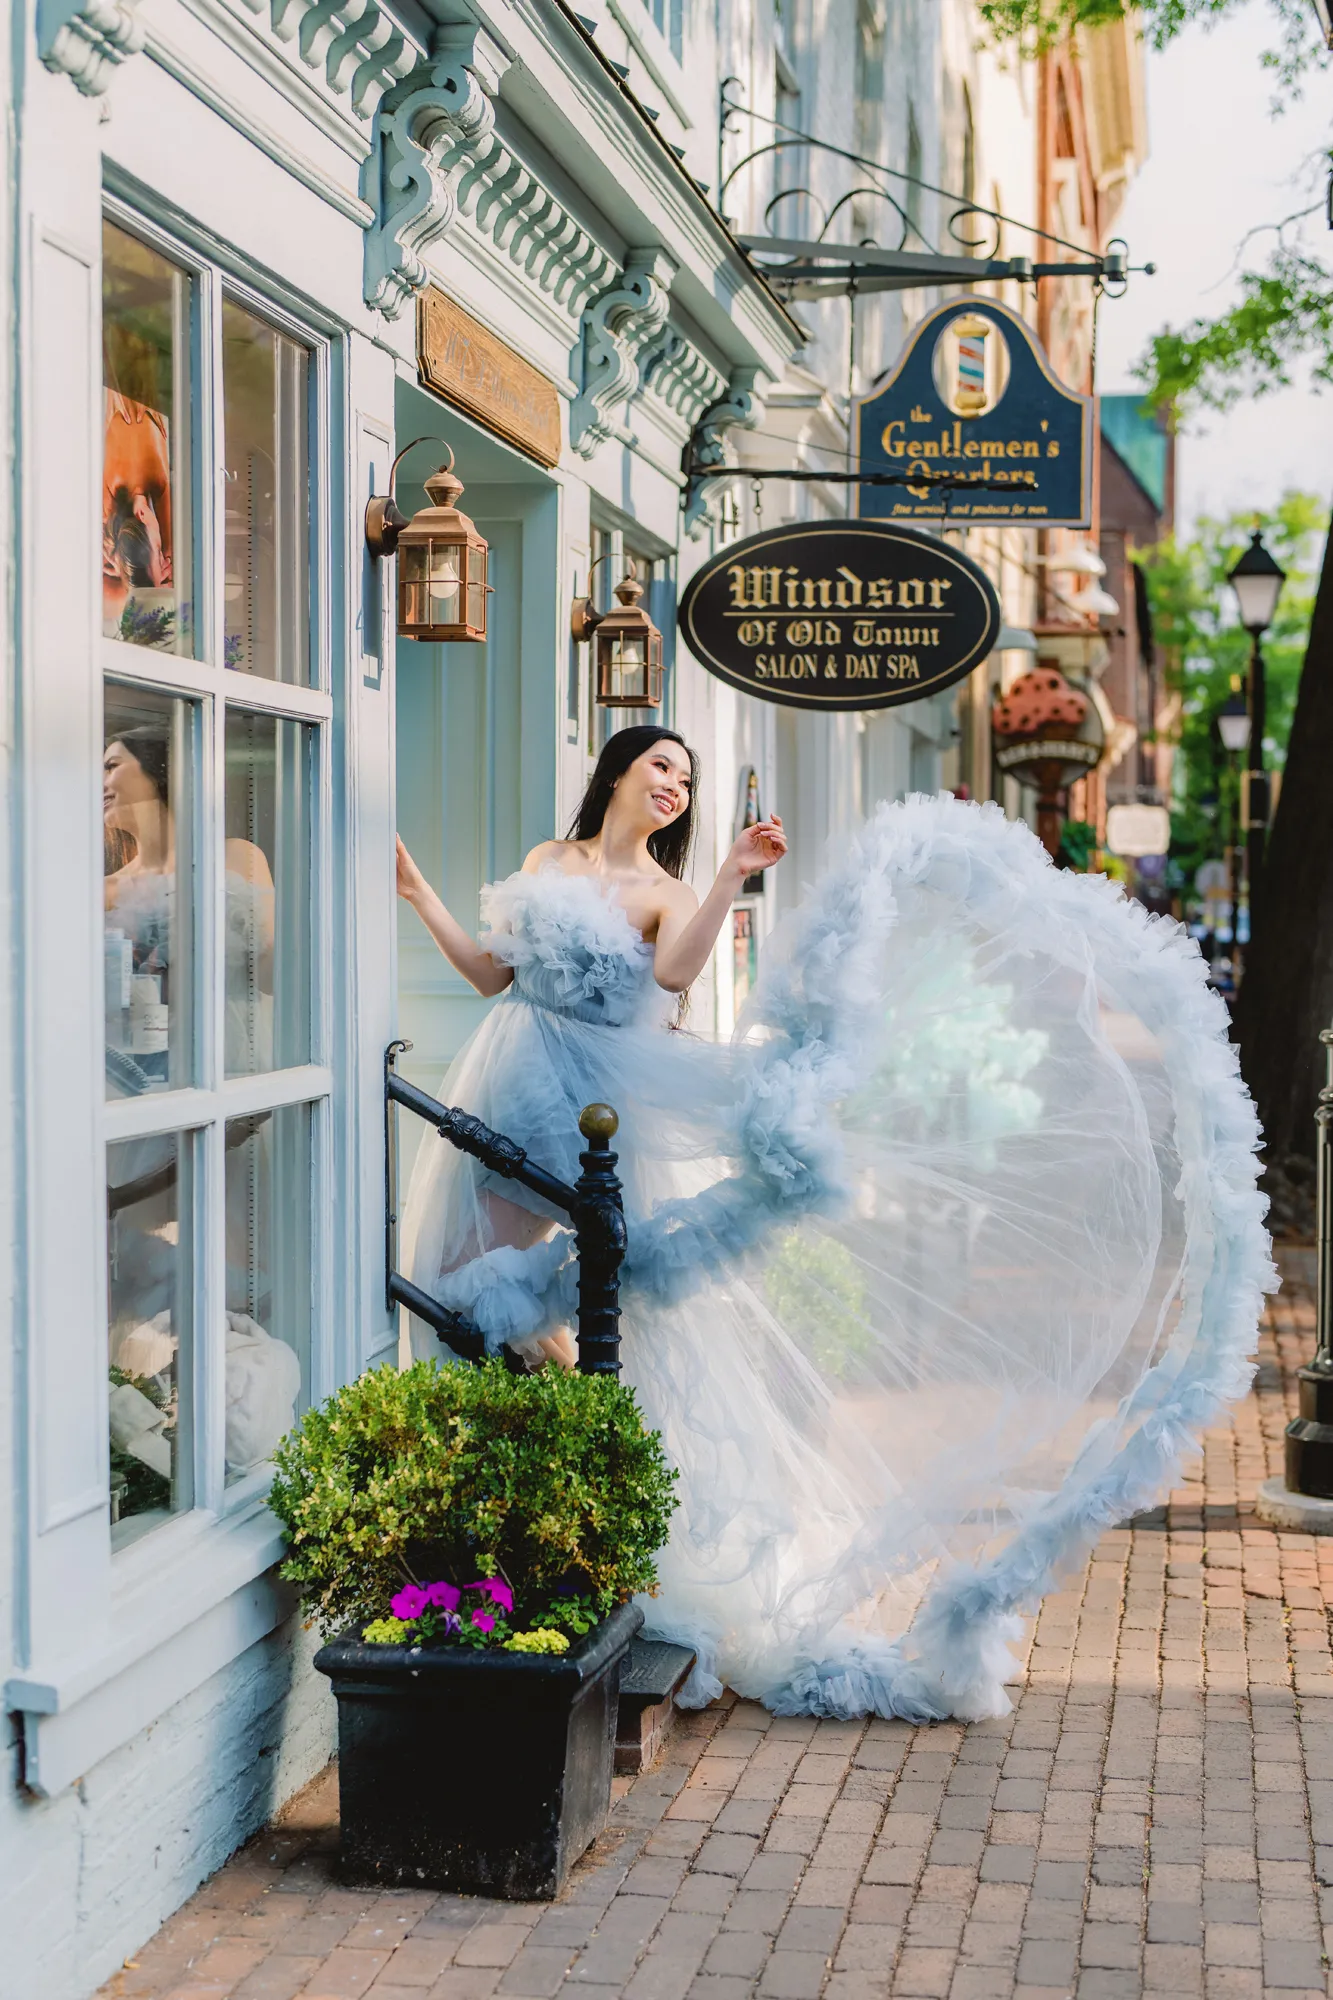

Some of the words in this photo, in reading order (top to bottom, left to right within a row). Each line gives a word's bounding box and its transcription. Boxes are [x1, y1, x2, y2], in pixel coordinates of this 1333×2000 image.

[910, 405, 933, 423] the
[881, 419, 1060, 458] Gentlemen's
[727, 565, 953, 609] Windsor
[737, 620, 777, 647] Of
[786, 620, 842, 647] Old
[852, 620, 940, 647] Town
[755, 654, 818, 679] SALON
[824, 654, 838, 679] &
[845, 654, 882, 679] DAY
[886, 654, 920, 679] SPA
